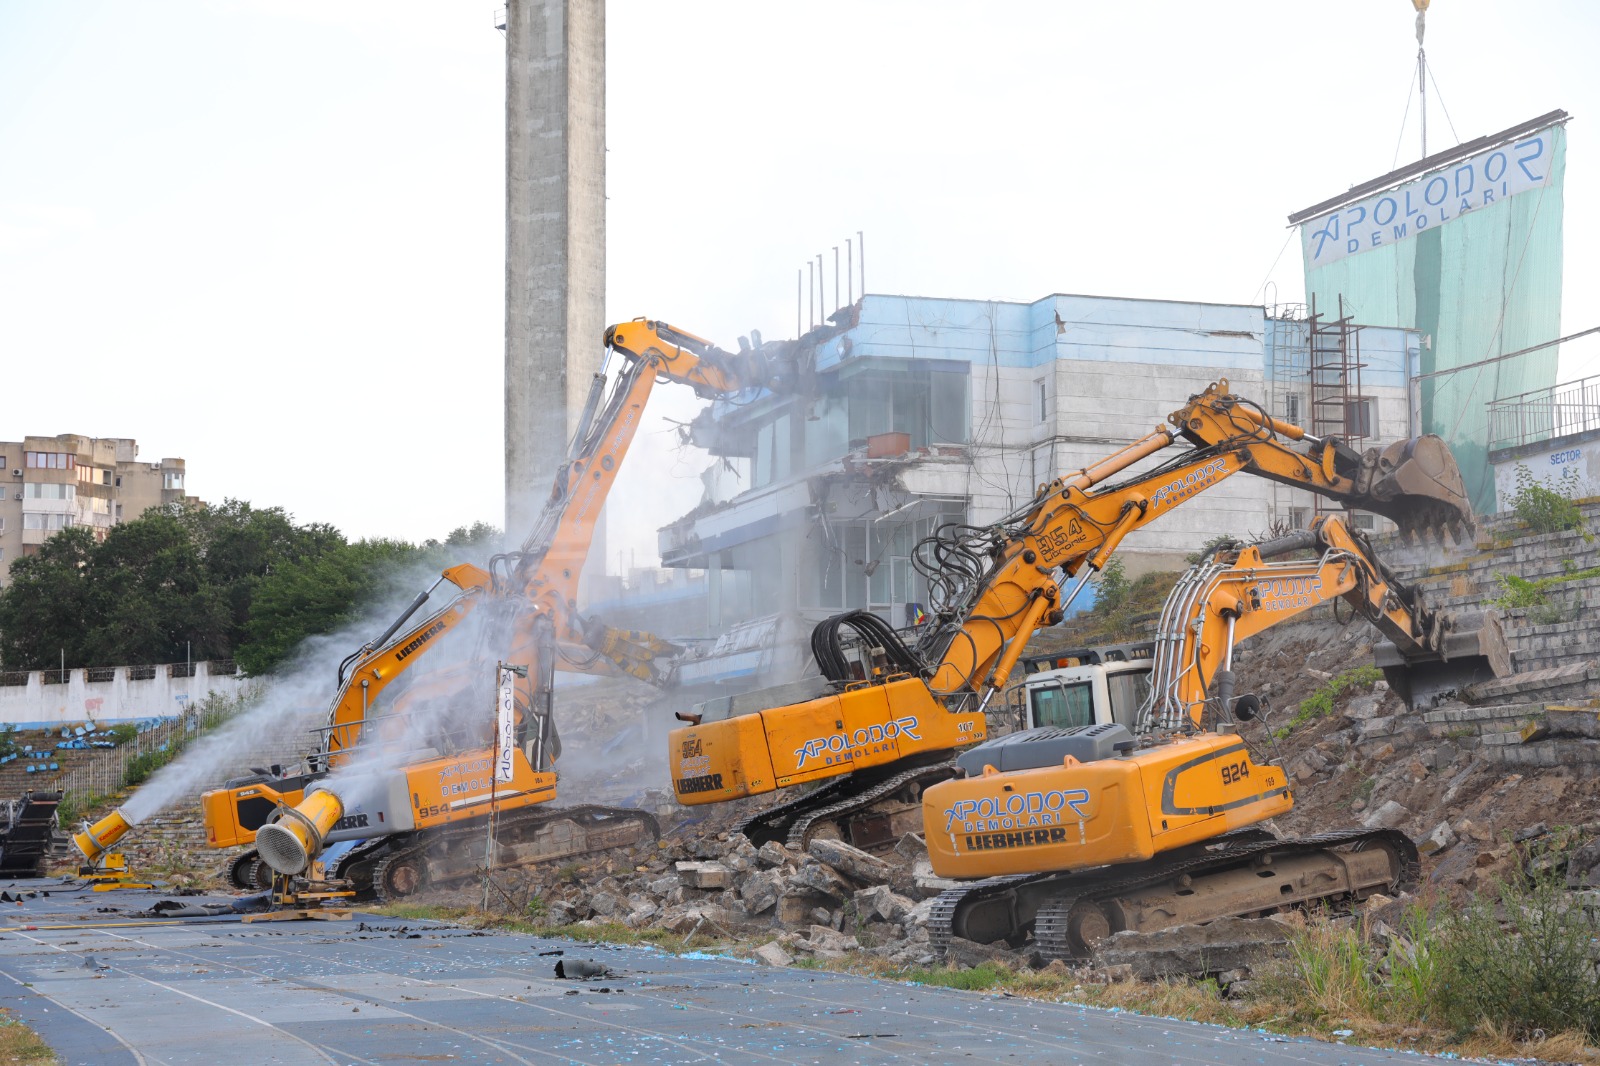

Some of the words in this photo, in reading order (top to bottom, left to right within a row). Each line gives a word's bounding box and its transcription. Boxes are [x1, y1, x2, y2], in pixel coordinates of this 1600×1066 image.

[1311, 137, 1544, 260] APOLODOR
[1347, 181, 1507, 254] DEMOLARI
[1550, 449, 1581, 465] SECTOR
[1150, 457, 1230, 509] APOLODOR
[1165, 475, 1217, 505] DEMOLARI
[1037, 517, 1083, 556] 954
[395, 621, 447, 662] LIEBHERR
[682, 738, 702, 759] 954
[794, 716, 922, 769] APOLODOR
[825, 741, 895, 765] DEMOLARI
[1221, 760, 1249, 786] 924
[419, 803, 450, 819] 954
[944, 789, 1091, 833] APOLODOR
[964, 813, 1061, 833] DEMOLARI
[966, 828, 1067, 851] LIEBHERR
